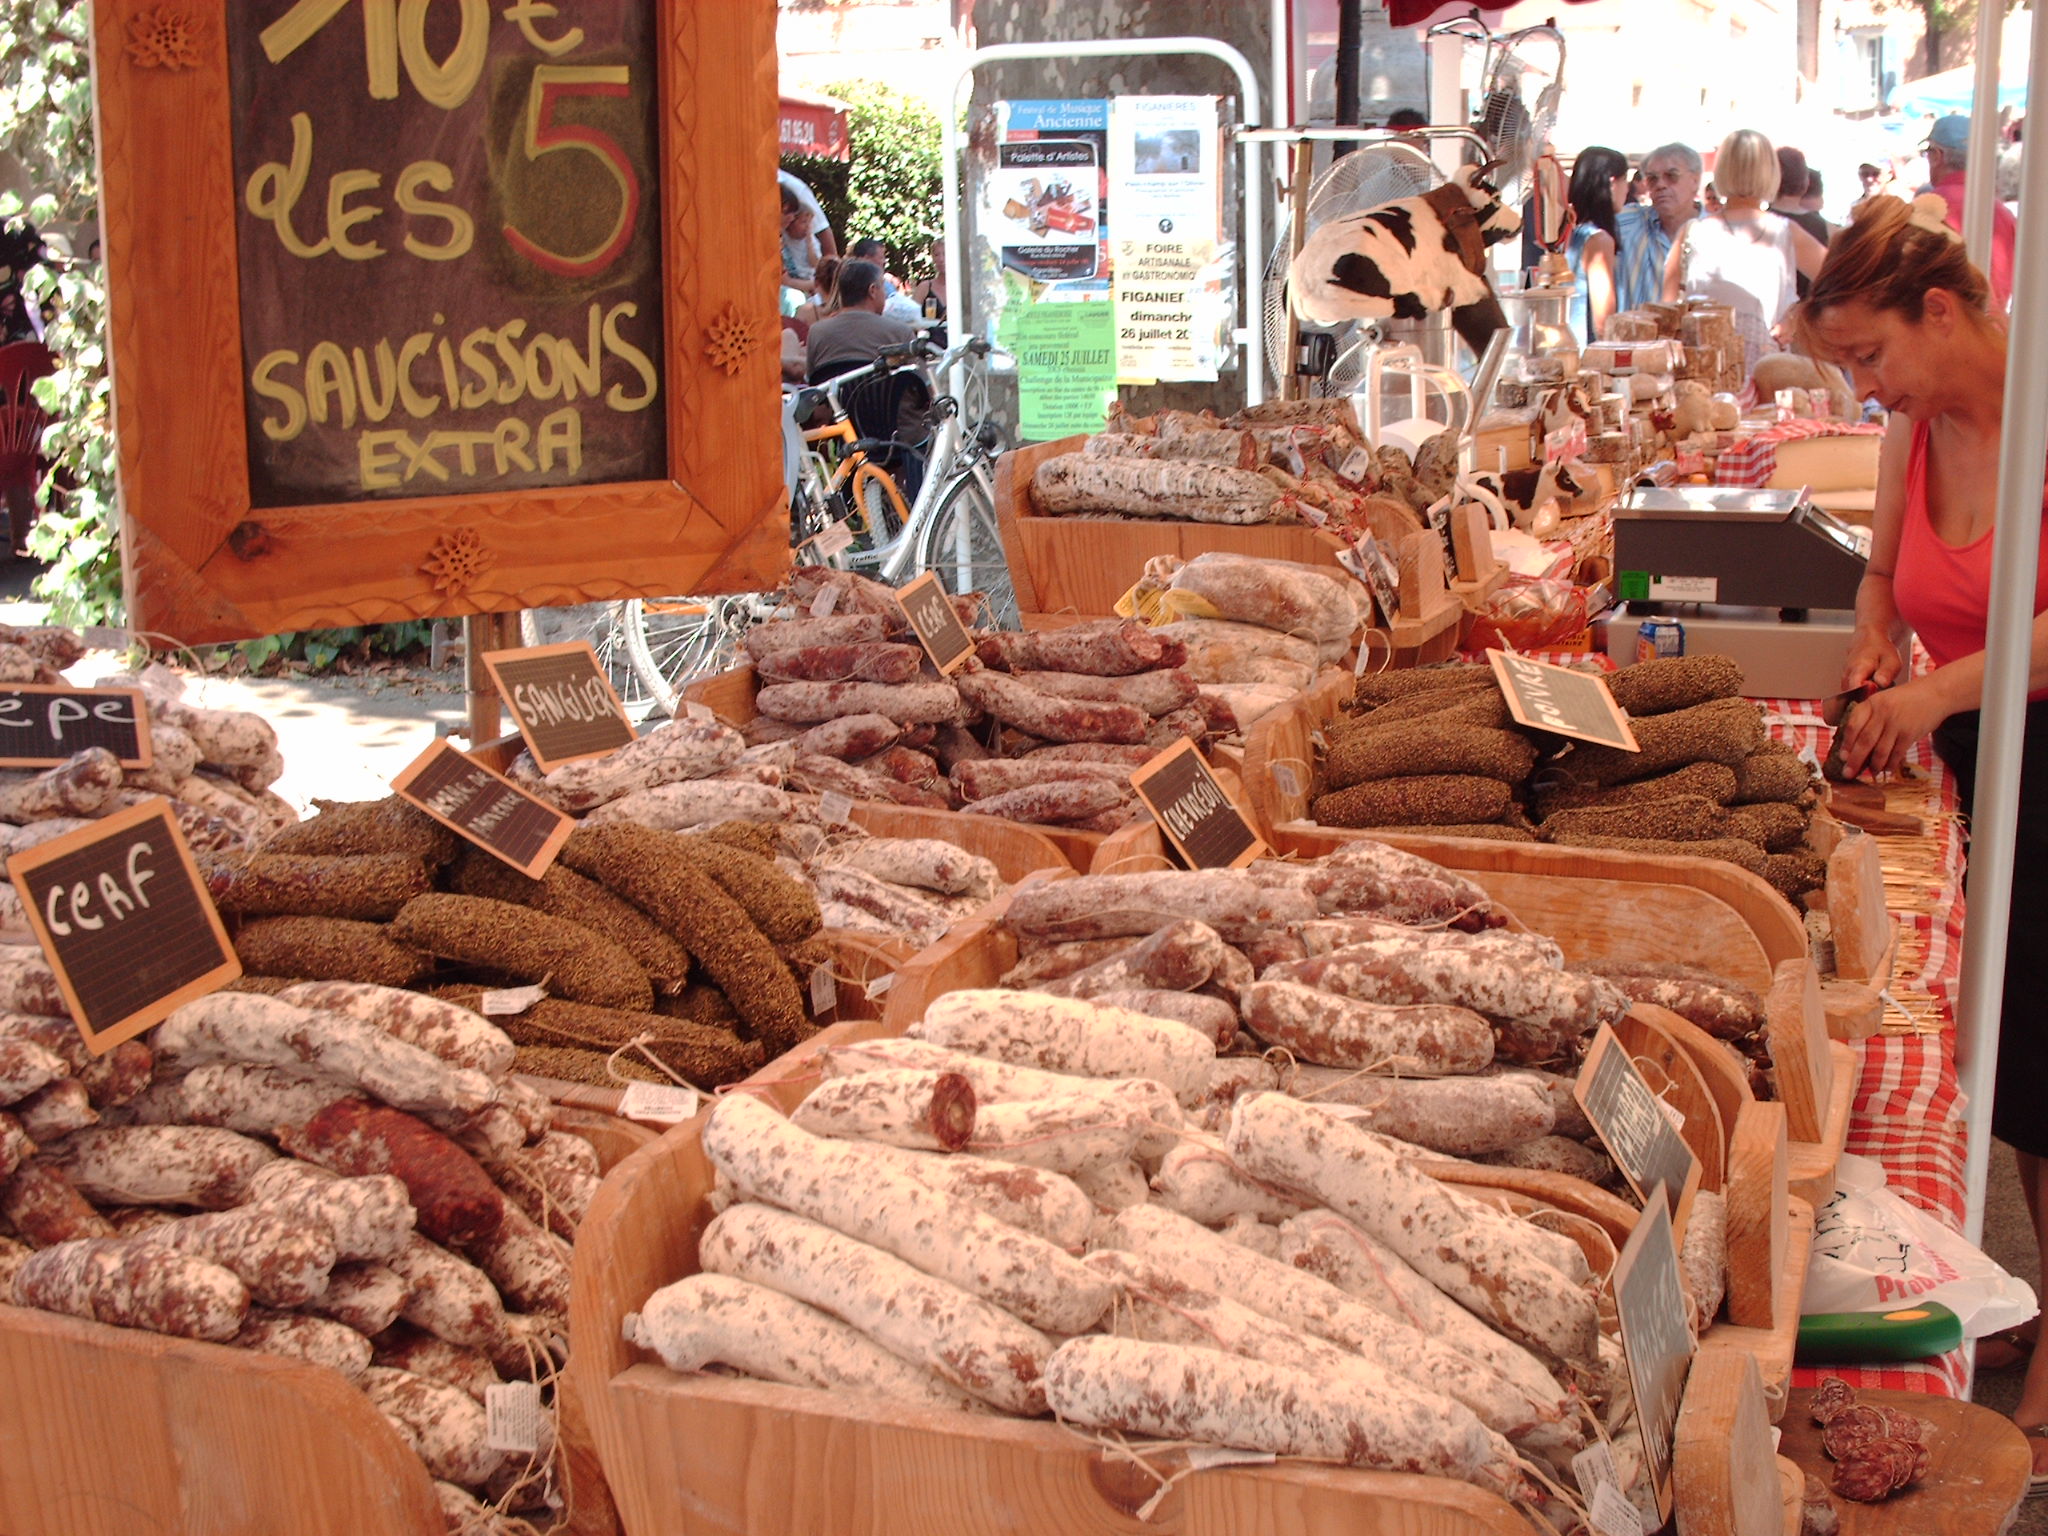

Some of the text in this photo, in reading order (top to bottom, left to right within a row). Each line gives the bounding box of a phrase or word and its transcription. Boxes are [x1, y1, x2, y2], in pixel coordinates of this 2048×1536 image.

[1060, 103, 1102, 117] Musique
[1034, 114, 1103, 129] Ancienne
[1010, 152, 1045, 162] Palette
[503, 64, 638, 277] 5
[1146, 243, 1184, 255] FOIRE
[1138, 257, 1191, 268] ARTISANALE
[1120, 328, 1136, 339] 26
[1138, 328, 1173, 342] juillet
[1022, 350, 1058, 366] SAMEDI
[1060, 350, 1070, 366] 25
[1071, 349, 1110, 365] JUILLET
[358, 407, 583, 490] EXTRA
